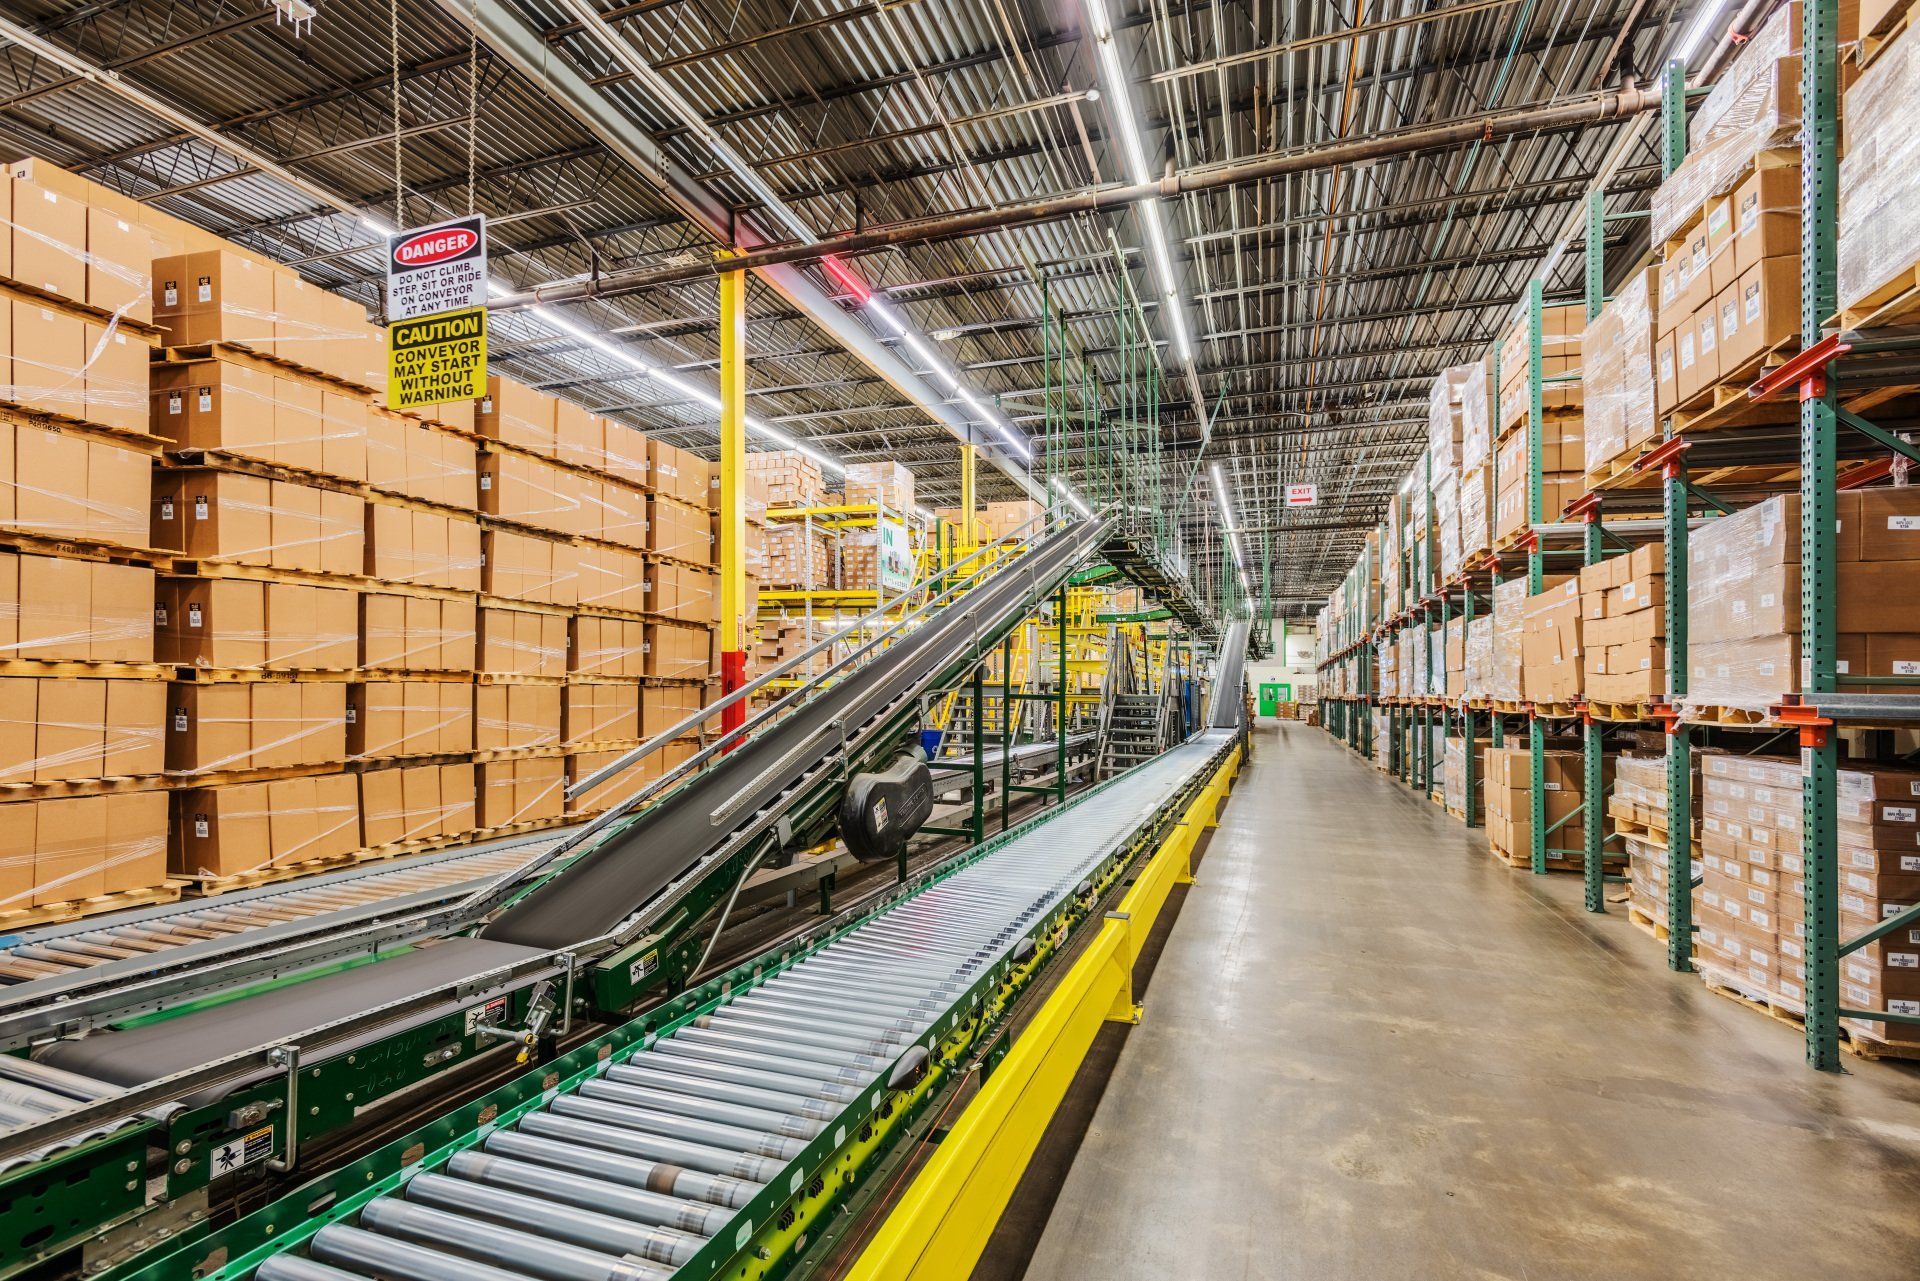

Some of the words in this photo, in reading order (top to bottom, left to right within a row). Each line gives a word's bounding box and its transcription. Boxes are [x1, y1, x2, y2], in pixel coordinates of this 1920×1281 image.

[402, 234, 468, 261] DANGER
[393, 284, 418, 297] STEP,
[422, 280, 437, 292] SIT
[441, 276, 454, 288] OR
[458, 271, 481, 285] RIDE
[400, 272, 412, 285] DO
[417, 268, 436, 283] NOT
[439, 262, 474, 278] CLIMB,
[401, 294, 415, 306] ON
[418, 284, 473, 302] CONVEYOR
[405, 305, 418, 316] AT
[421, 301, 441, 312] ANY
[445, 295, 469, 309] TIME
[396, 317, 479, 346] CAUTION
[395, 340, 480, 364] CONVEYOR
[394, 362, 425, 379] MAY
[432, 354, 481, 373] START
[401, 369, 474, 391] WITHOUT
[400, 383, 474, 405] WARNING
